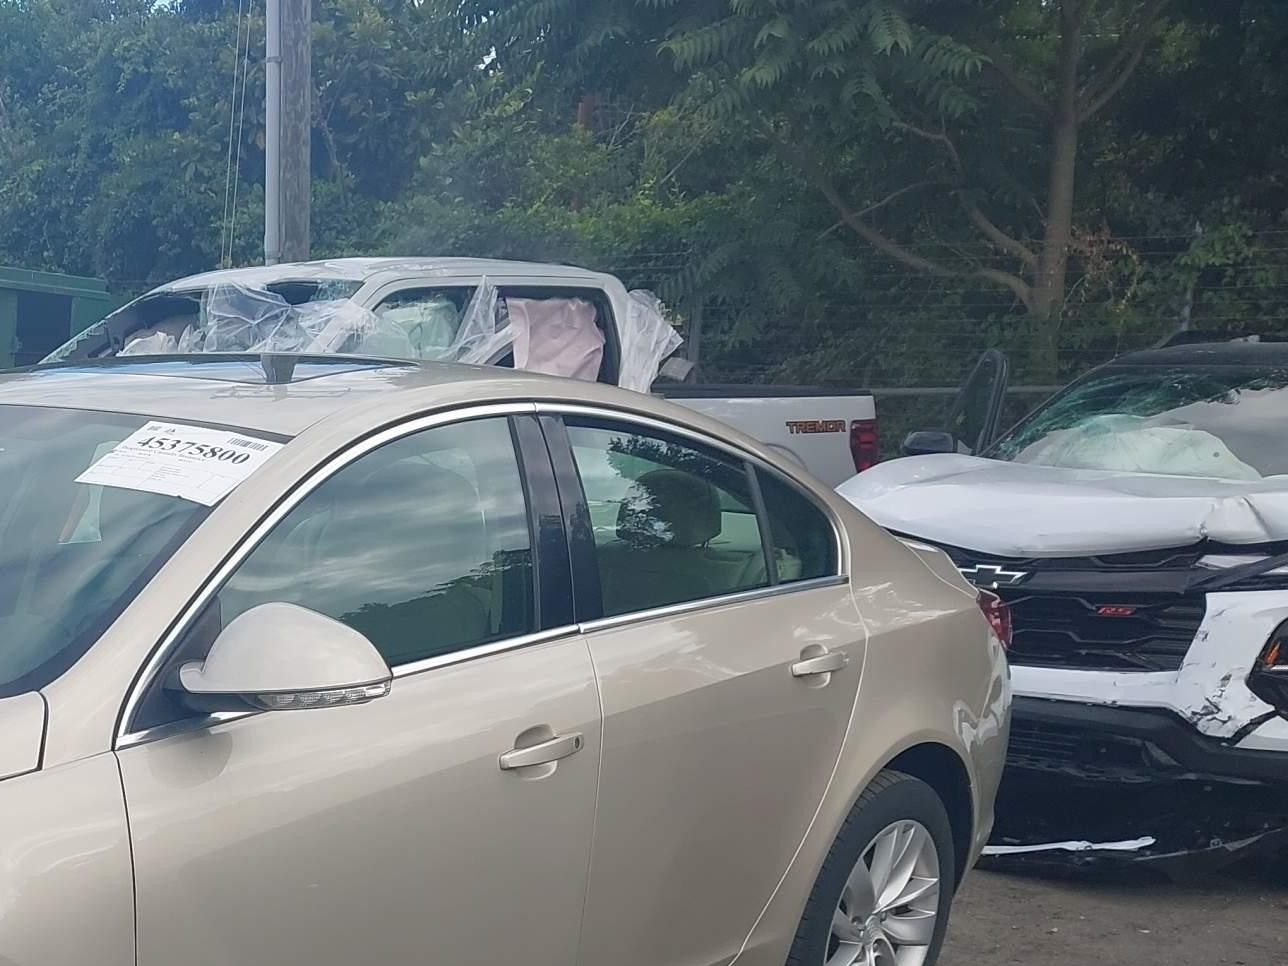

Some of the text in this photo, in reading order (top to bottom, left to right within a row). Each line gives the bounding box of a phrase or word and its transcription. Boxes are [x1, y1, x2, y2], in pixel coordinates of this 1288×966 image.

[785, 420, 847, 434] TREMOR
[137, 436, 251, 465] 45375800
[1097, 607, 1134, 616] RS
